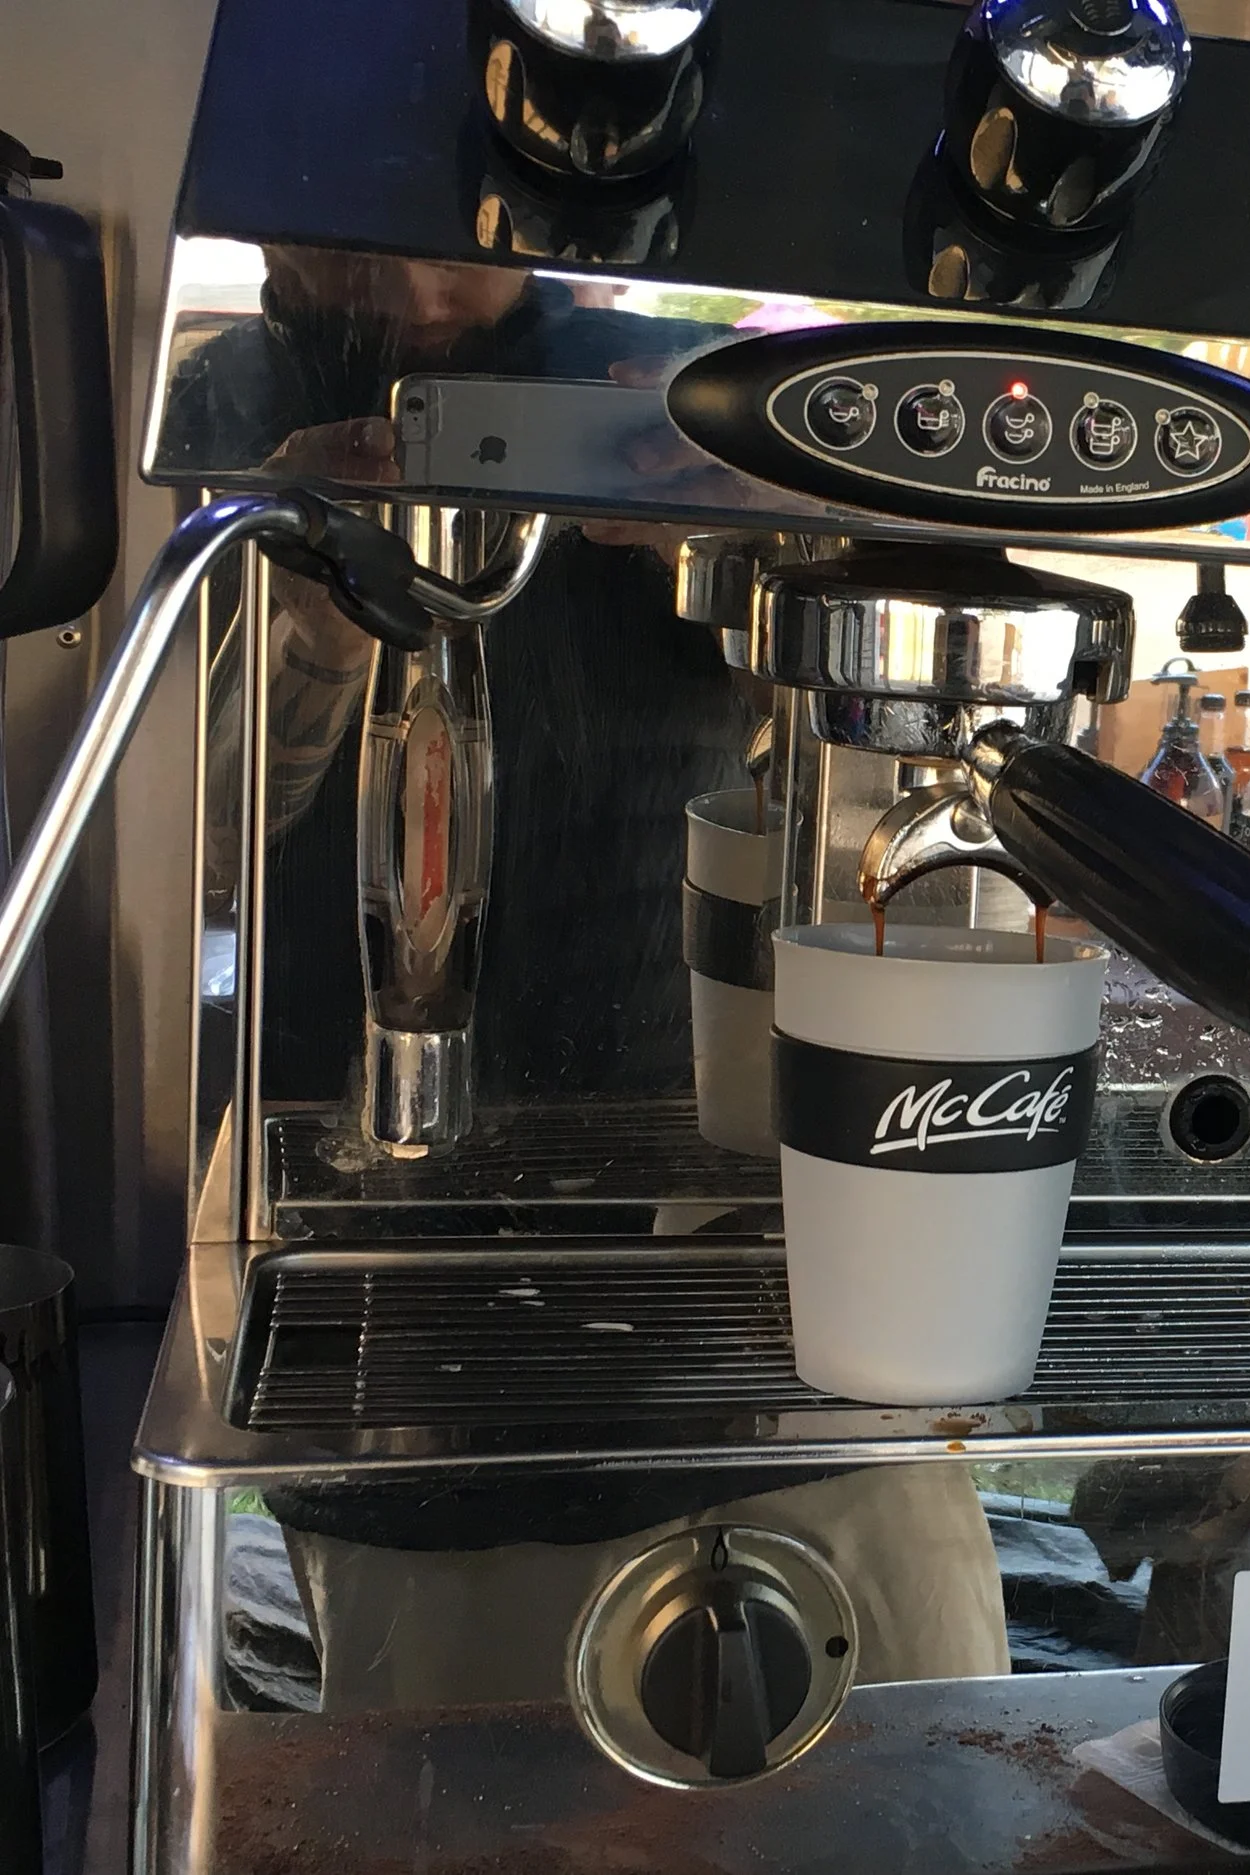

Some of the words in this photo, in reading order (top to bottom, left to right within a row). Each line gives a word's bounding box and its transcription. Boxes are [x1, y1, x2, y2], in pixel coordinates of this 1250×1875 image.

[1080, 484, 1103, 494] Made
[1106, 484, 1114, 493] in
[1115, 481, 1150, 493] England
[875, 1066, 1074, 1151] McCafé
